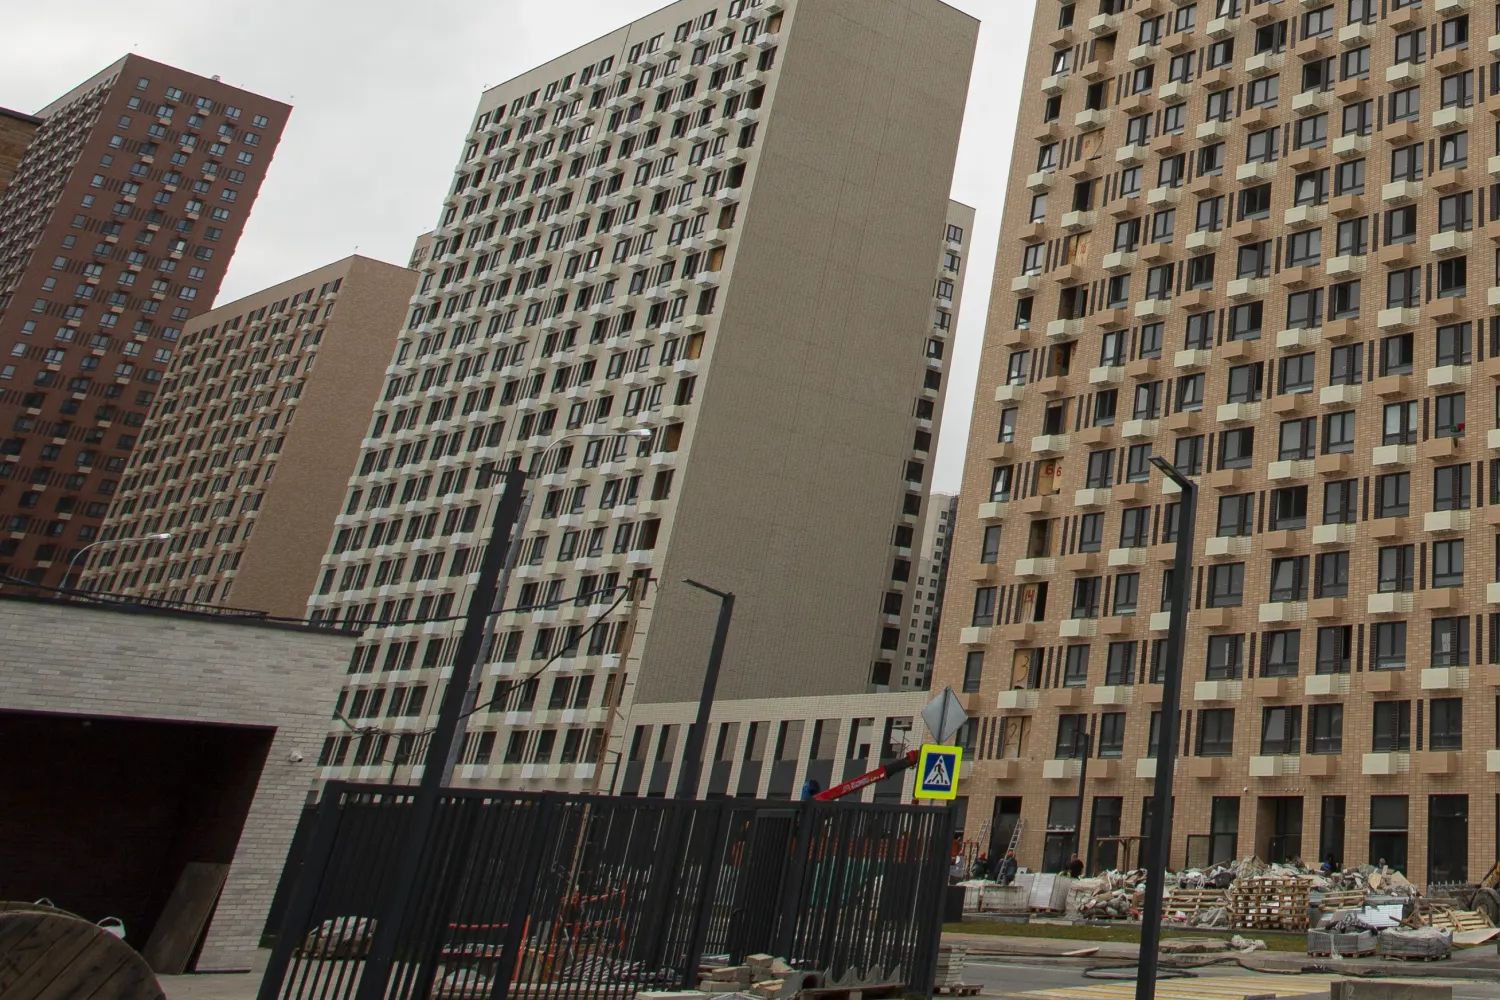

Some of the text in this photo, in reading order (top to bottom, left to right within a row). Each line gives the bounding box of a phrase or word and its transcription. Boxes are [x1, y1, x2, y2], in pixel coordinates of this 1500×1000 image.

[1045, 463, 1062, 477] 6 6
[1017, 655, 1030, 683] 3
